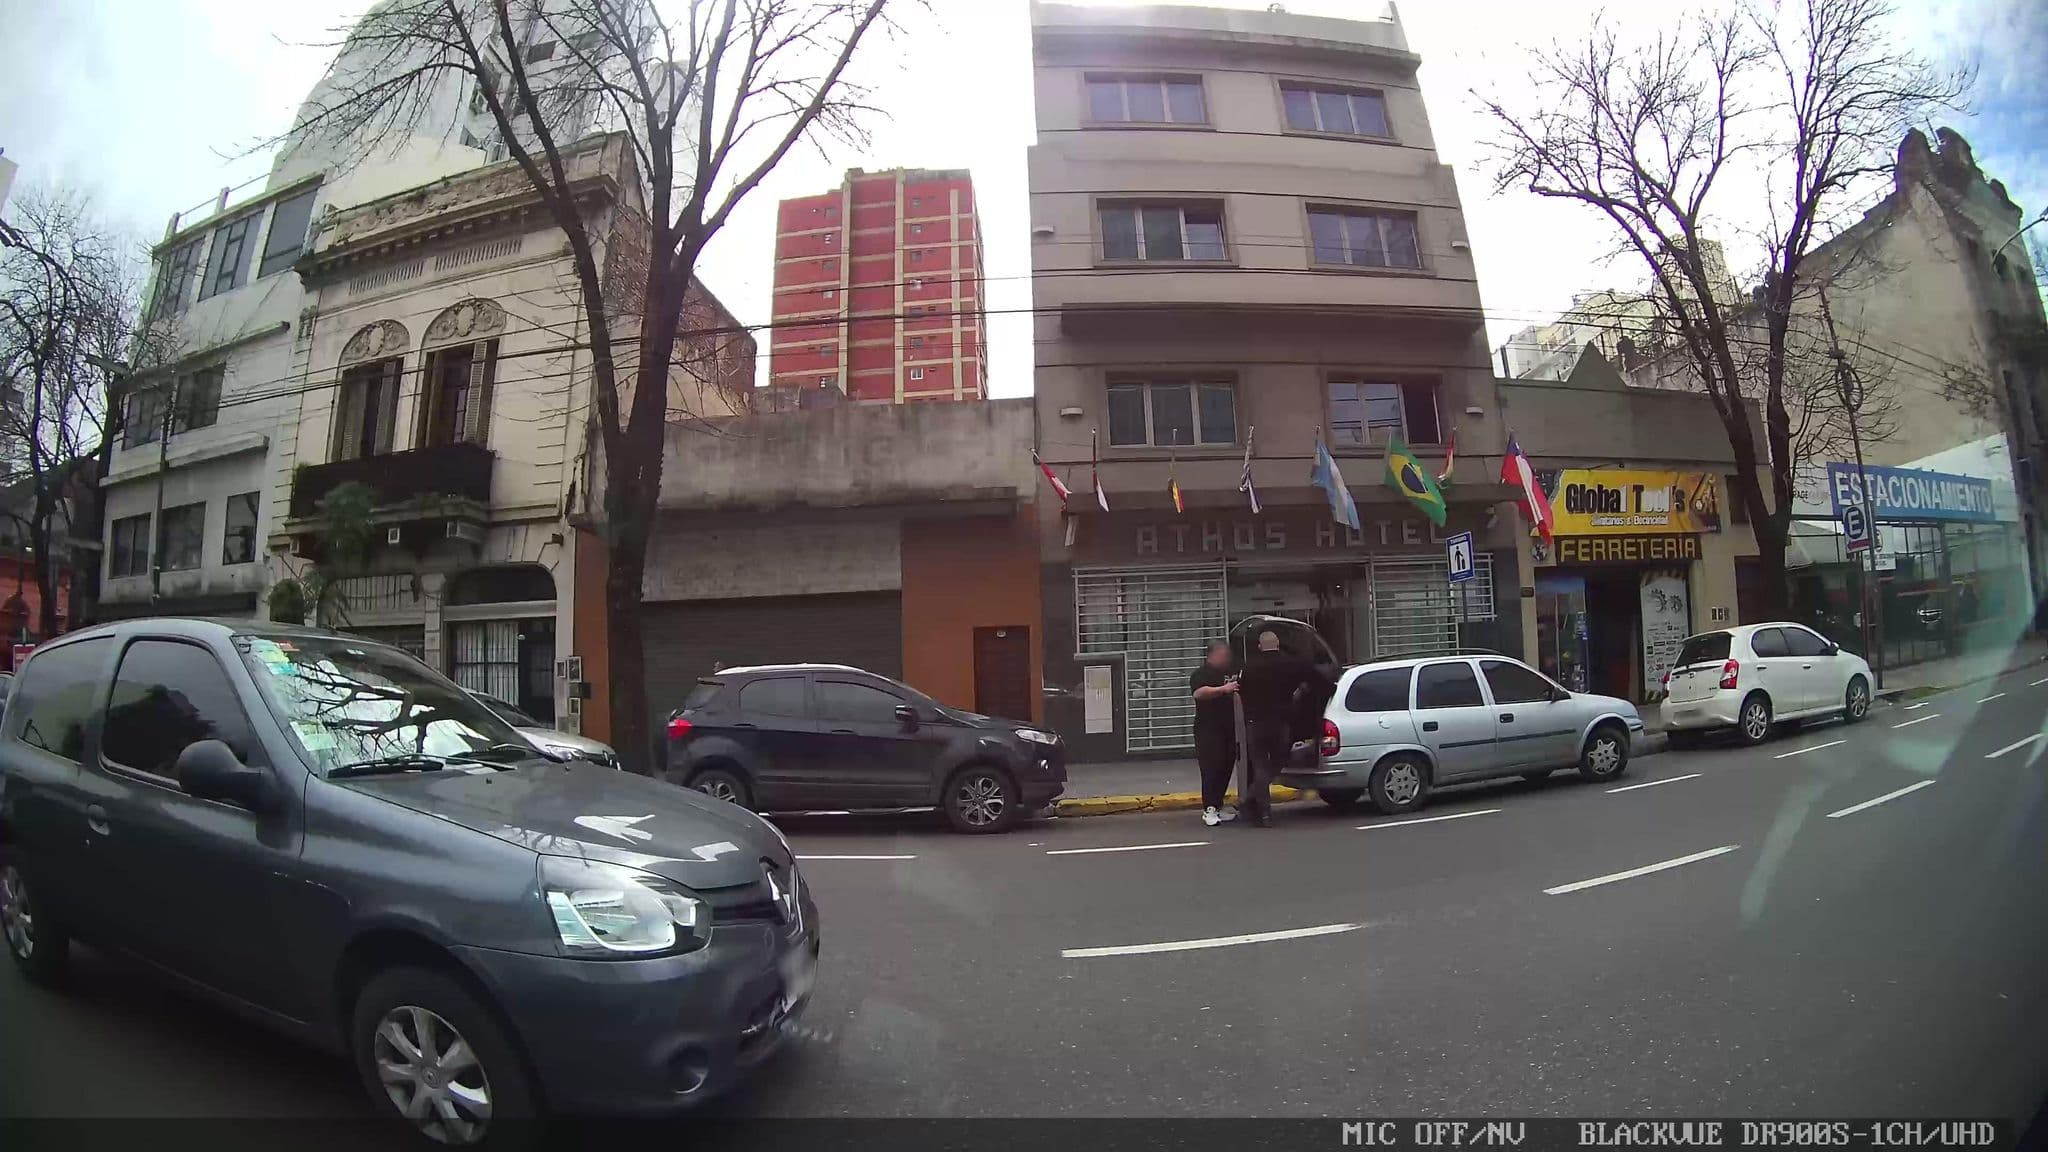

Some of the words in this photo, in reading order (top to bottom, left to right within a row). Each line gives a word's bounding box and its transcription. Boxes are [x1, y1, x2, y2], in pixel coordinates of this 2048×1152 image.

[1566, 483, 1627, 514] Global
[1834, 471, 1992, 513] ESTACIONAMIENTO
[1137, 520, 1287, 553] ATHOS
[1315, 517, 1447, 547] HOTEL
